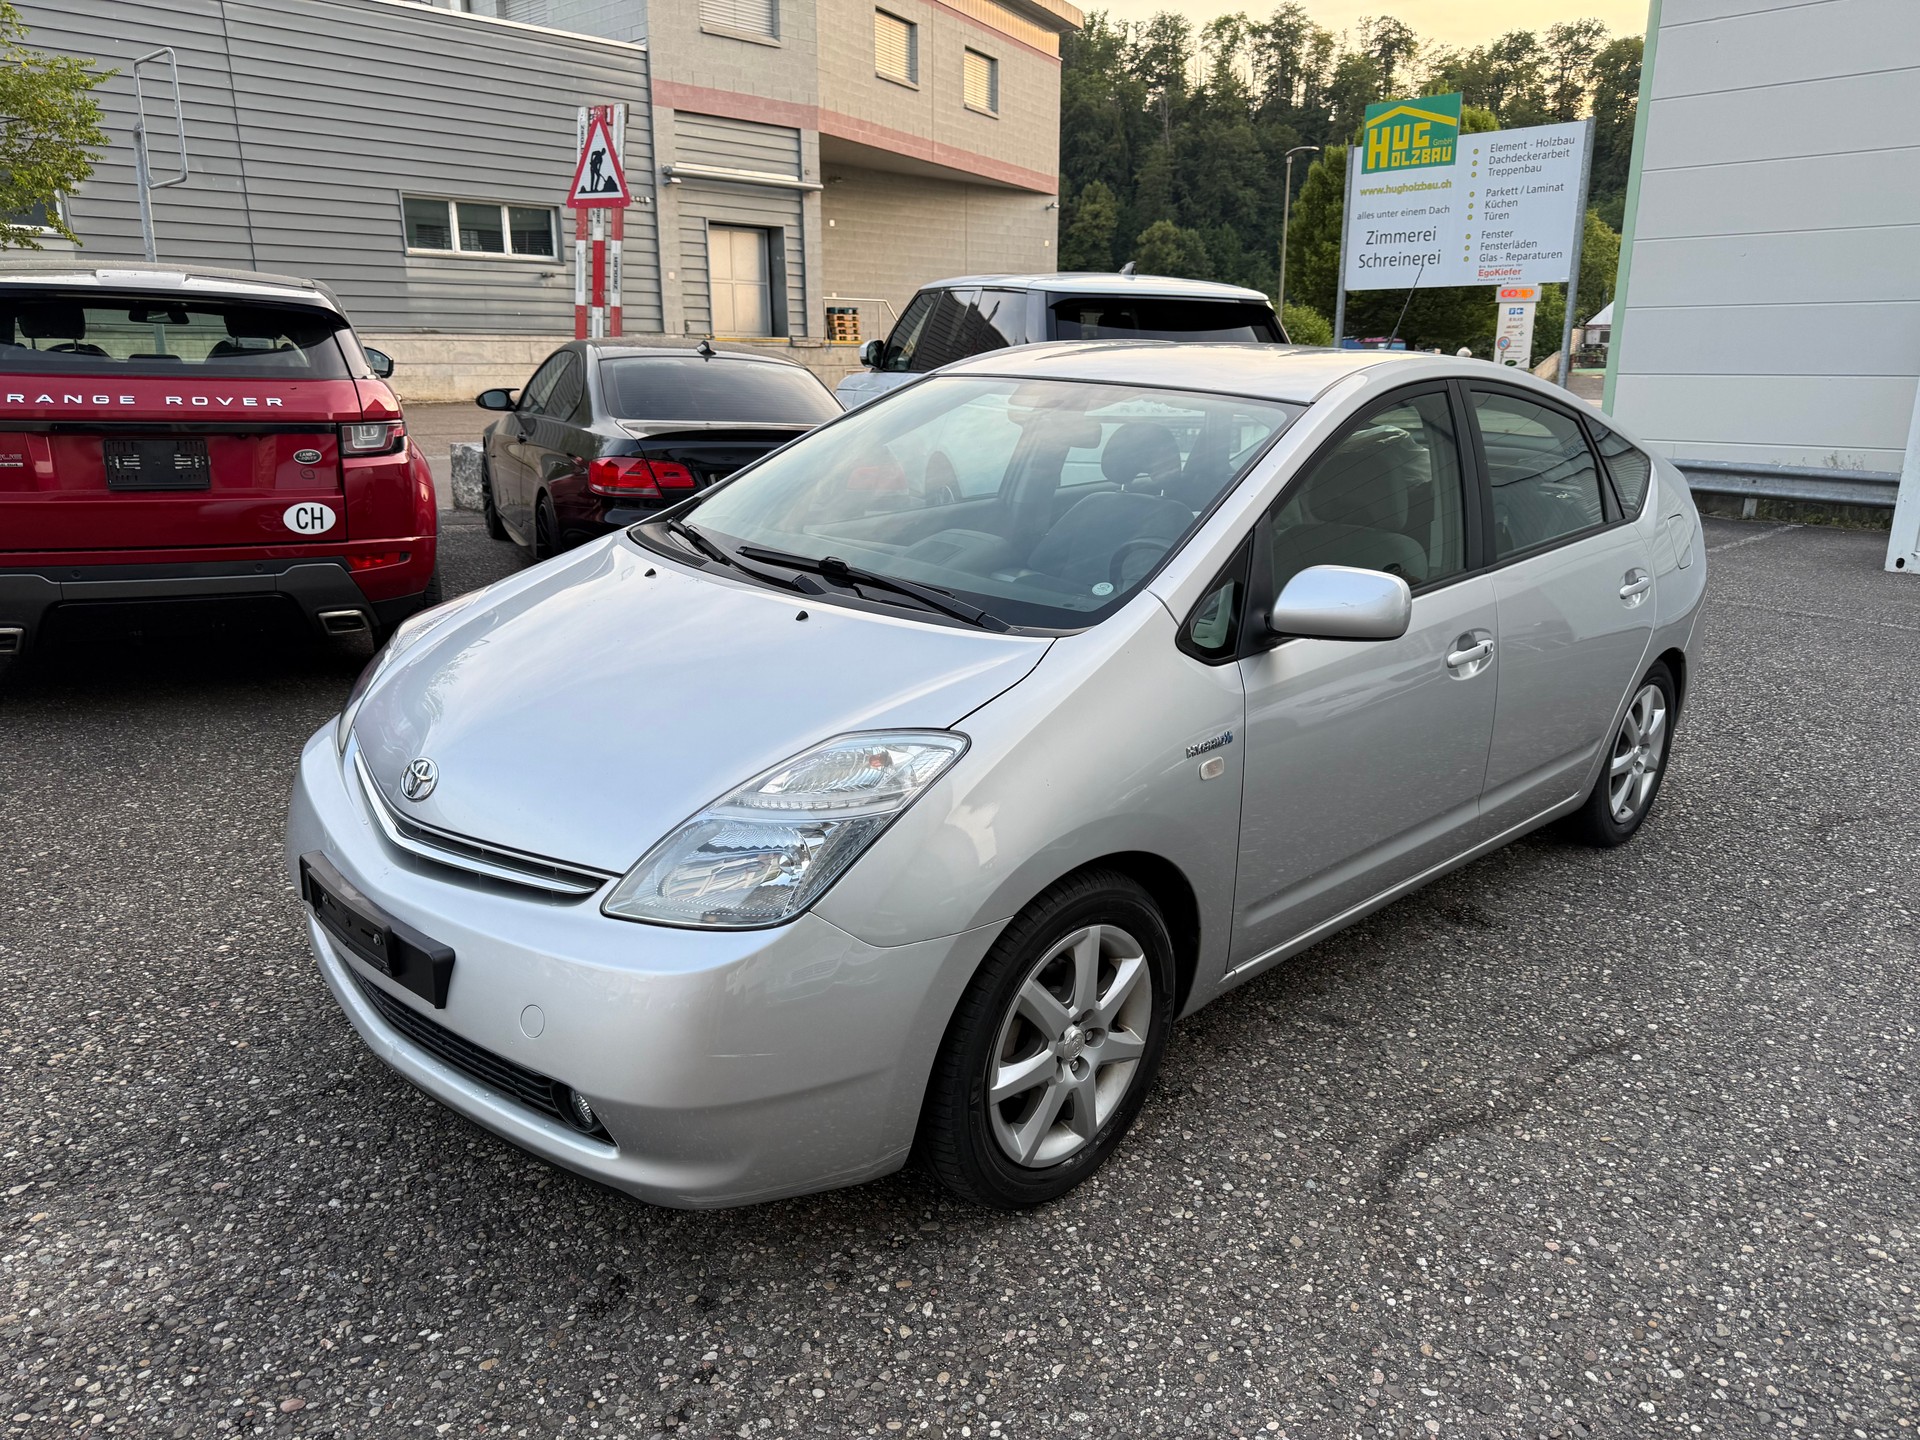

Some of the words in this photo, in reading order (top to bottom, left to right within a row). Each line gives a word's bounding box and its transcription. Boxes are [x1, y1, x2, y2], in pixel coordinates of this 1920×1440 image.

[1367, 122, 1431, 170] HUG
[1433, 138, 1453, 146] GmbH
[1490, 141, 1527, 153] Element
[1536, 136, 1575, 148] Holzbau
[1489, 148, 1570, 165] Dachdeckerarbeit
[1488, 164, 1542, 177] Treppenbau
[1360, 179, 1452, 196] www.hugholzbau.ch
[1486, 187, 1518, 197] Parkett
[1526, 183, 1564, 194] Laminat
[1485, 199, 1518, 209] Küchen
[1357, 211, 1374, 220] alles
[1376, 210, 1399, 218] unter
[1400, 208, 1426, 217] einem
[1429, 205, 1450, 215] Dach
[1484, 211, 1510, 221] Türen
[1365, 225, 1437, 245] Zimmerei
[1481, 230, 1514, 239] Fenster
[1480, 239, 1537, 251] Fensterläden
[1358, 249, 1441, 269] Schreinerei
[1480, 253, 1498, 262] Glas
[1505, 250, 1563, 263] Reparaturen
[1478, 268, 1522, 278] EgoKiefer
[7, 393, 136, 405] RANGE
[165, 395, 284, 407] ROVER
[295, 507, 325, 531] CH
